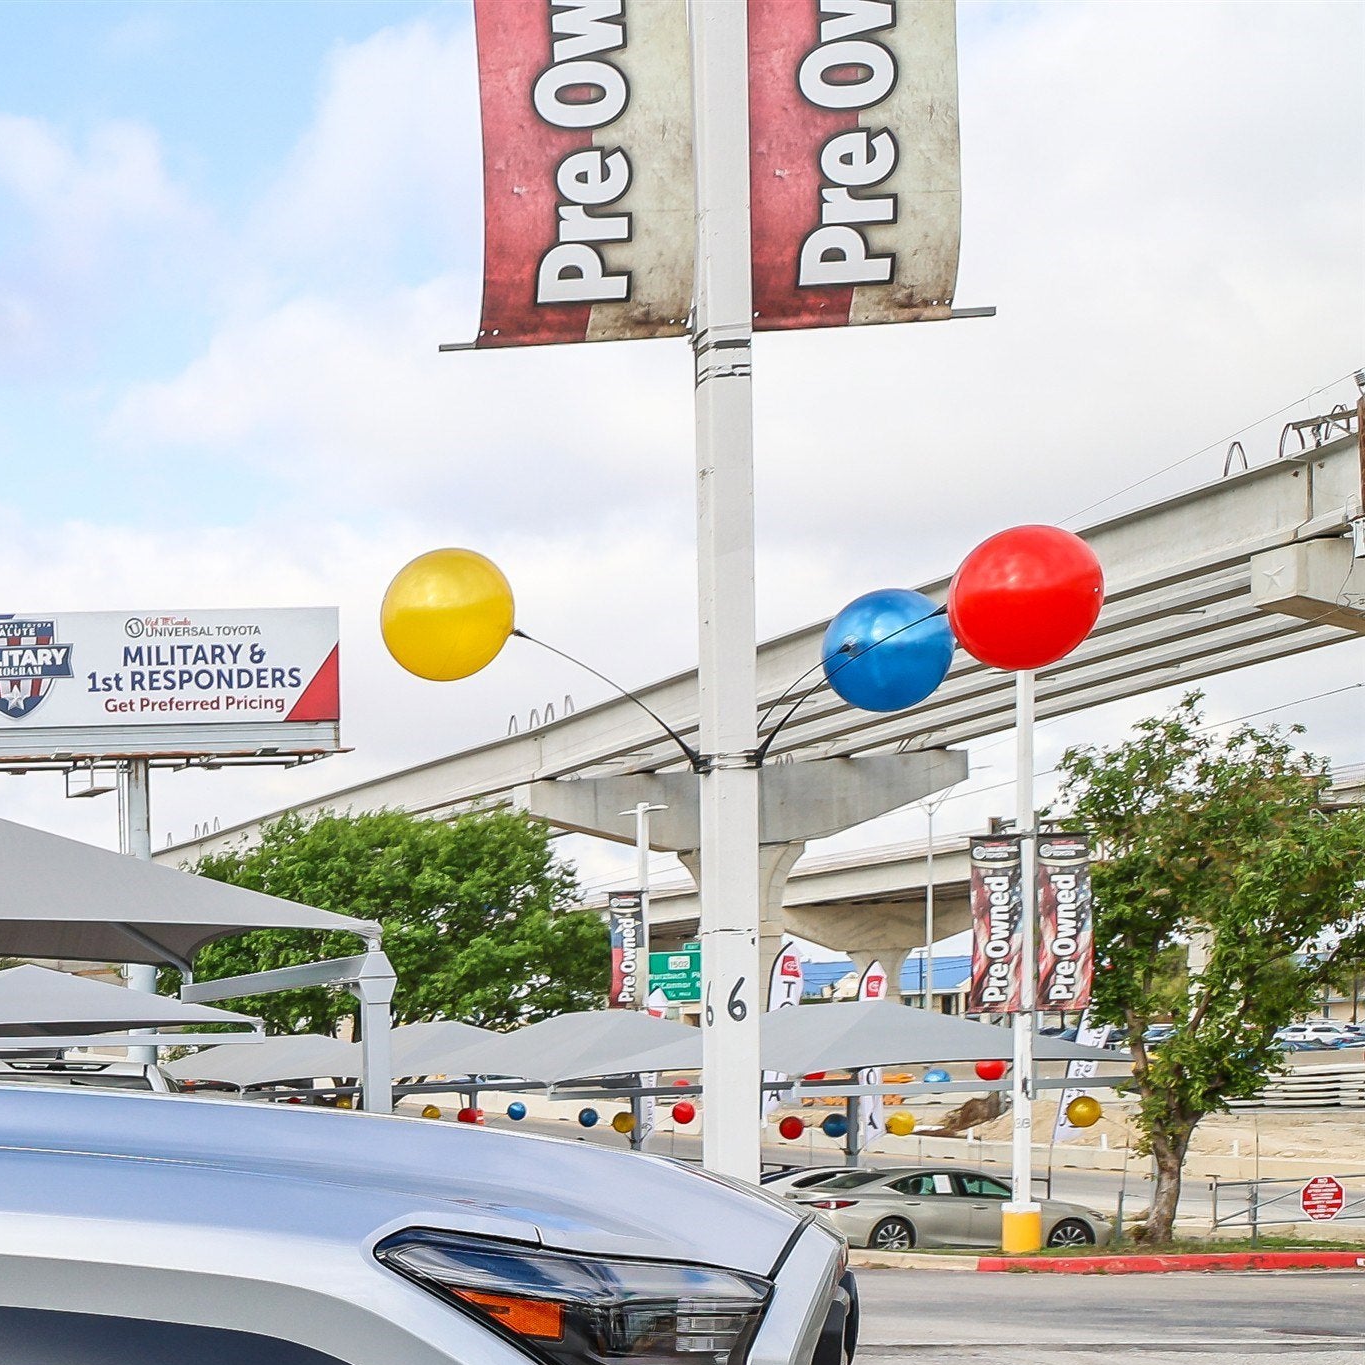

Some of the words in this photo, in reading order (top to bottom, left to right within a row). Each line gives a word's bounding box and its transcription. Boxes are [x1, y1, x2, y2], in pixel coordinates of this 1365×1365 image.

[535, 146, 632, 305] Pre
[797, 126, 899, 288] Pre
[145, 626, 214, 637] UNIVERSAL
[215, 625, 262, 636] TOYOTA
[122, 643, 243, 667] MILITARY
[249, 643, 267, 664] &
[87, 671, 123, 692] 1st
[130, 667, 302, 691] RESPONDERS
[104, 698, 136, 713] Get
[140, 696, 220, 712] Preferred
[225, 695, 285, 713] Pricing
[983, 875, 1011, 959] Owned
[1050, 874, 1077, 957] Owned
[618, 917, 637, 974] Owned
[617, 974, 636, 1002] Pre
[727, 976, 747, 1022] 6
[982, 961, 1009, 1003] Pre
[1048, 959, 1076, 1000] Pre
